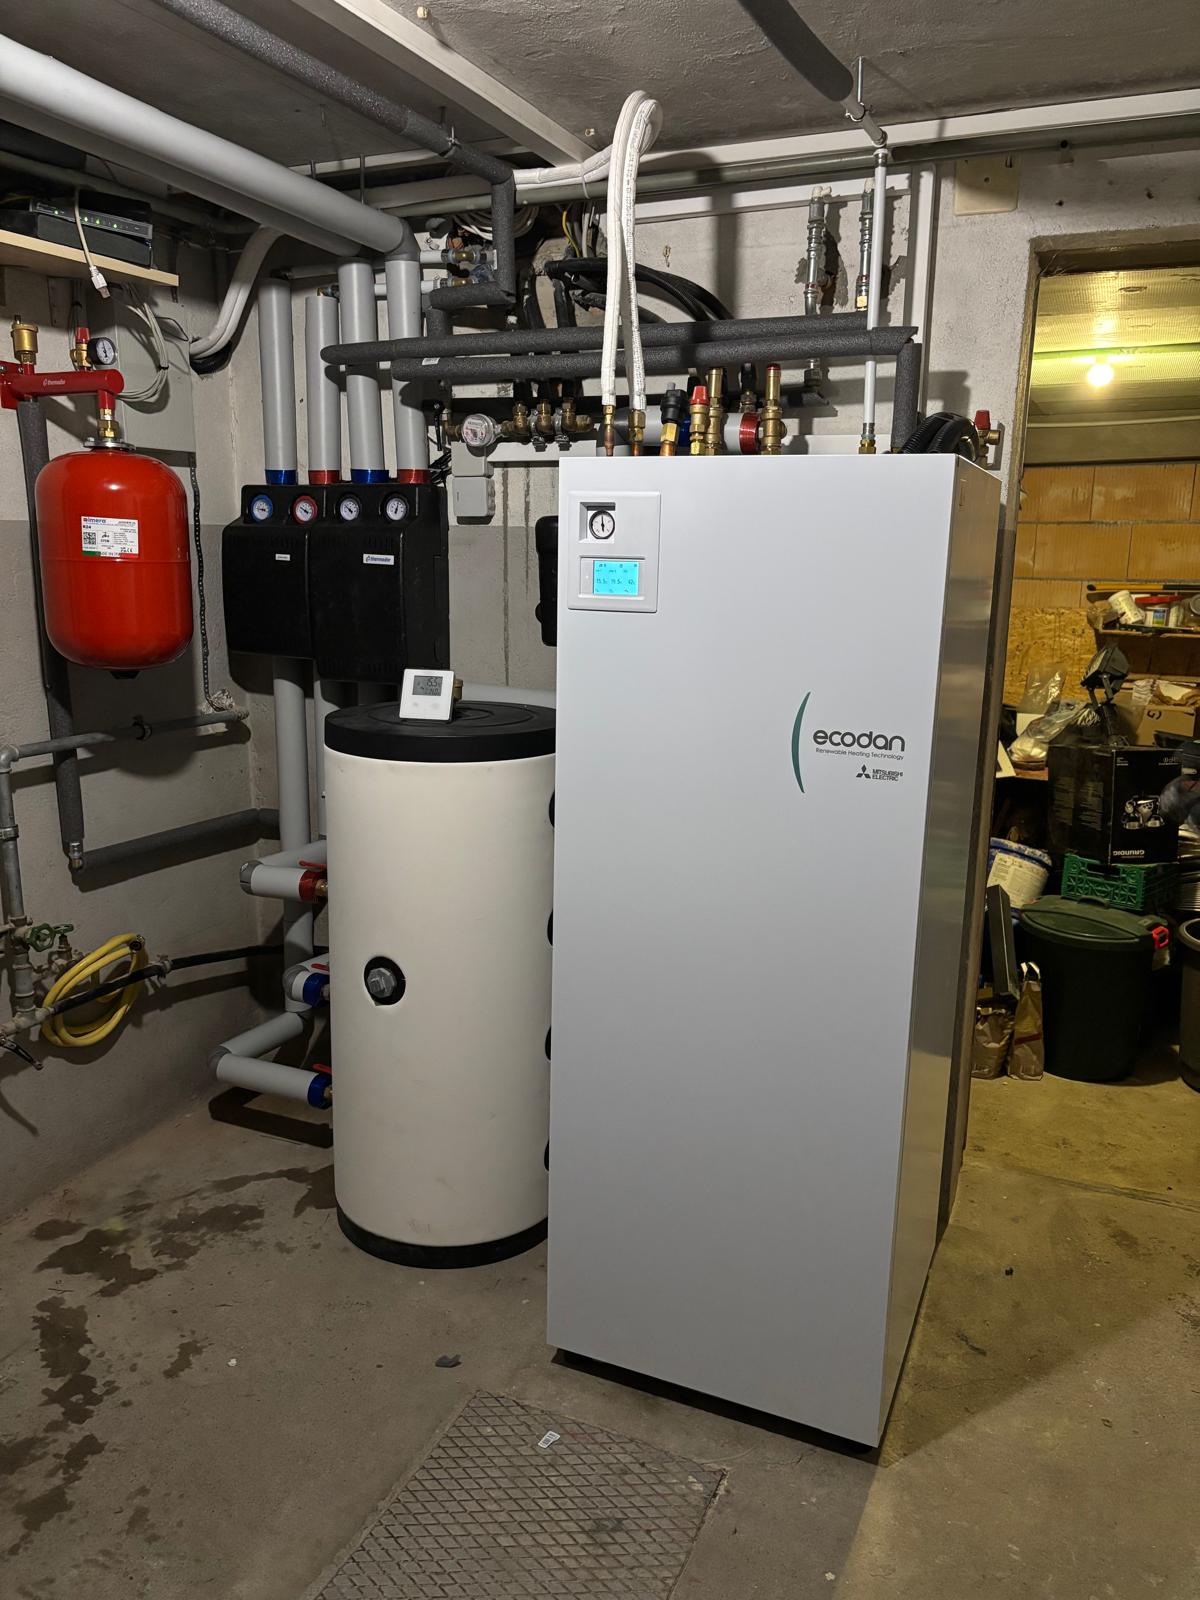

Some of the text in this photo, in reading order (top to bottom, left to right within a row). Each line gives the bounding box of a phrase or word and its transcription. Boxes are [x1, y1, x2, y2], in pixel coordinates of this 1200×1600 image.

[813, 730, 905, 752] ecodan
[816, 747, 904, 760] Renewable Heating Technology
[872, 774, 899, 782] ELECTRIC
